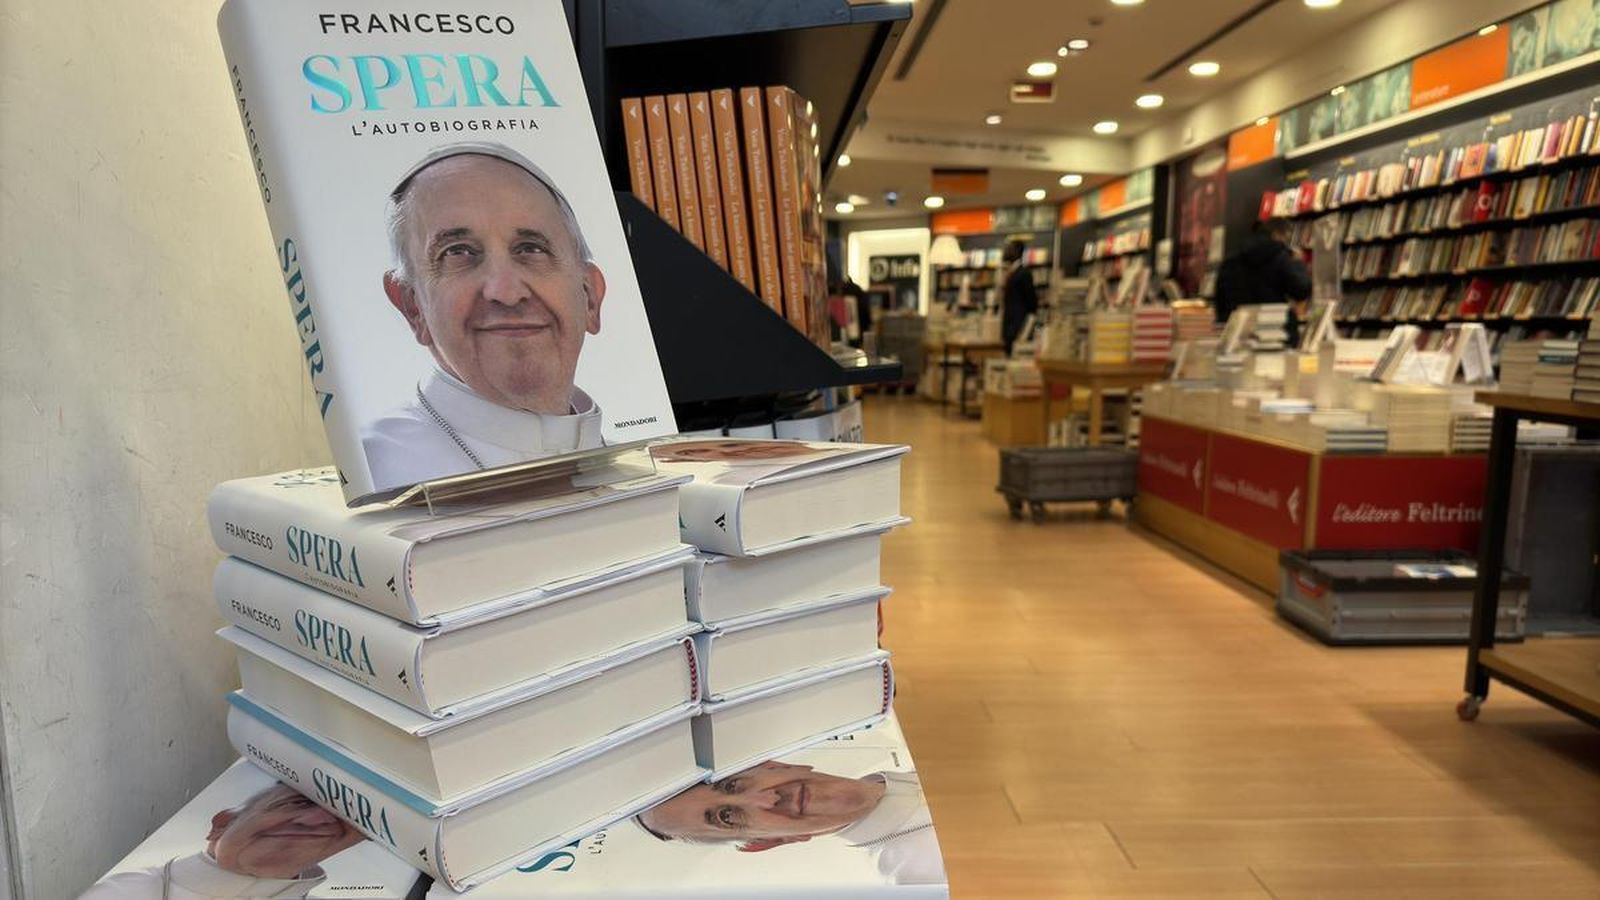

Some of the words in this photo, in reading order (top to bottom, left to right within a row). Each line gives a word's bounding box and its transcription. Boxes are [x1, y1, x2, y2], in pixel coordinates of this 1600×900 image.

[318, 13, 515, 35] FRANCESCO
[302, 53, 561, 114] SPERA
[231, 64, 273, 204] FRANCESCO
[351, 119, 540, 137] L'AUTOBIOGRAFIA
[278, 237, 335, 421] SPERA
[614, 416, 658, 429] MONDADORI
[225, 521, 274, 551] FRANCESCO
[285, 525, 366, 589] SPERA
[231, 600, 281, 632] FRANCESCO
[295, 609, 376, 678] SPERA
[246, 743, 300, 784] FRANCESCO
[312, 766, 398, 848] SPERA
